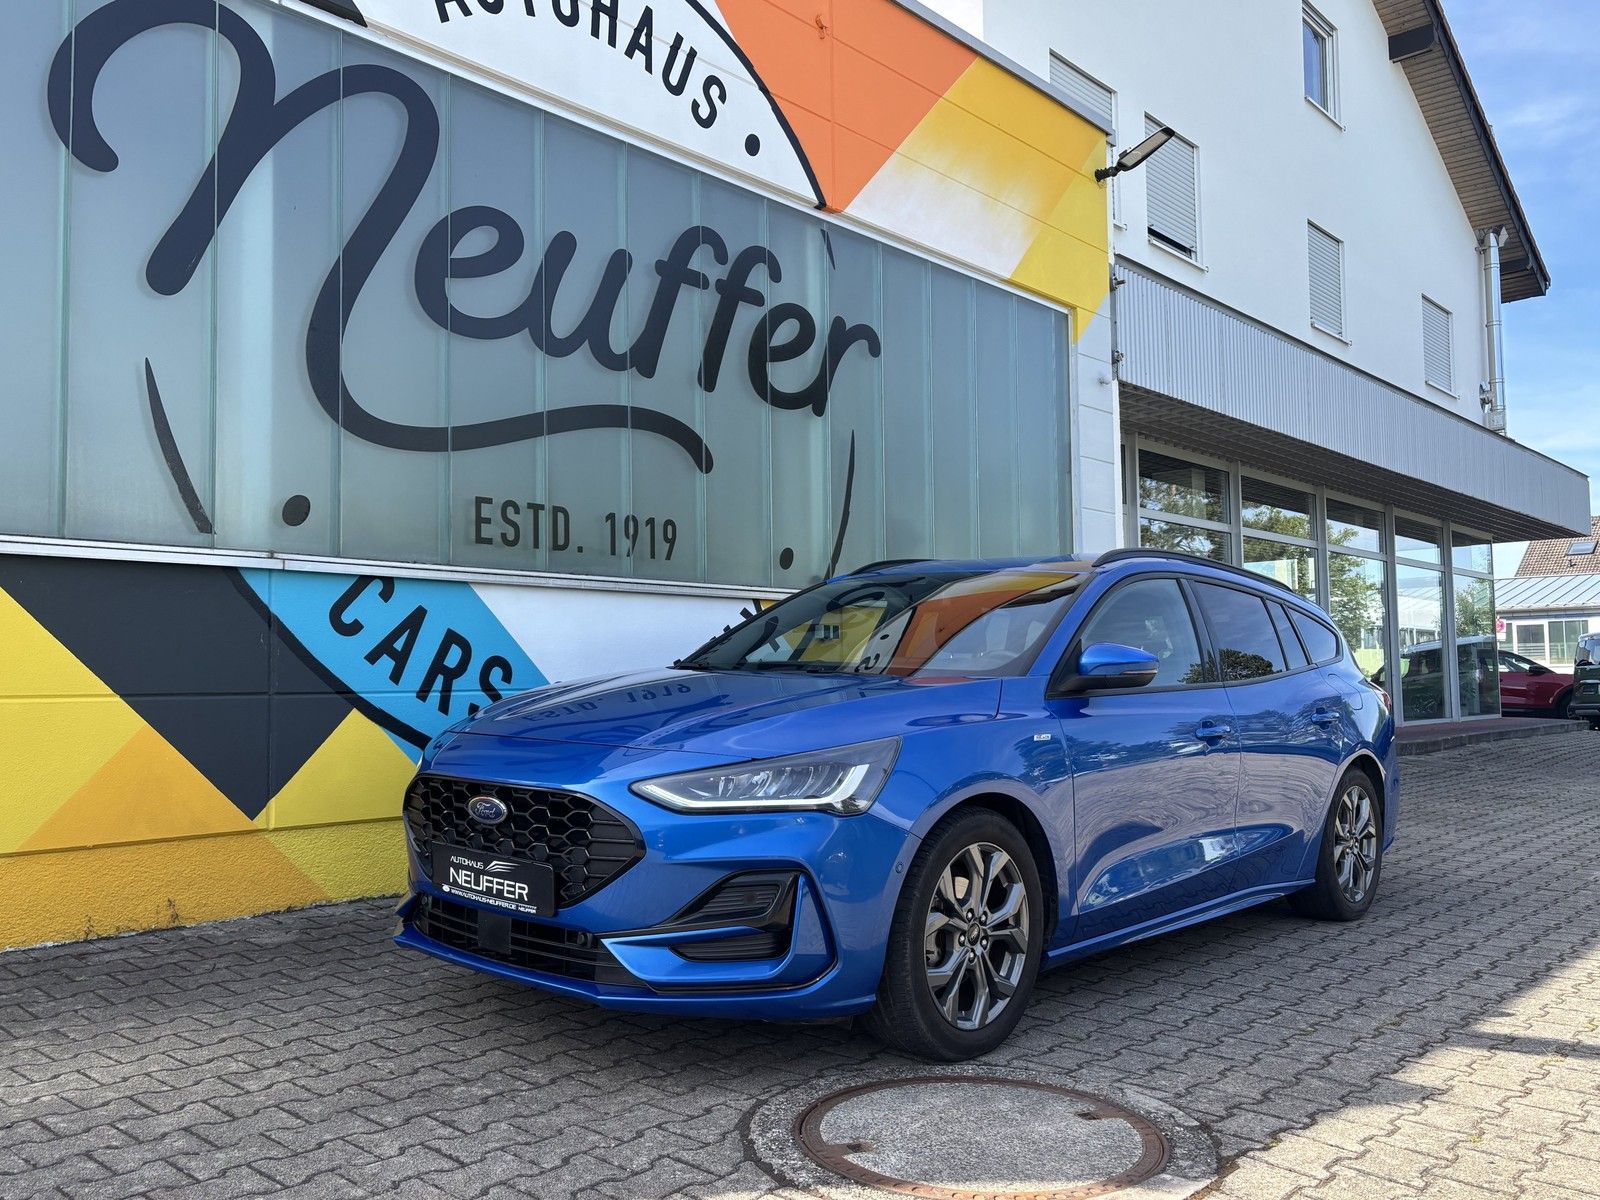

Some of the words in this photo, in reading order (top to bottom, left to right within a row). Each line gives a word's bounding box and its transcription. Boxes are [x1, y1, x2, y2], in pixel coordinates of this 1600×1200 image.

[436, 0, 727, 129] HAUS
[474, 496, 584, 553] ESTD.
[605, 512, 677, 561] 1919
[329, 575, 513, 717] CARS
[474, 801, 498, 818] Ford
[449, 866, 528, 901] NEUFFER
[450, 855, 484, 870] AUTOHAUS
